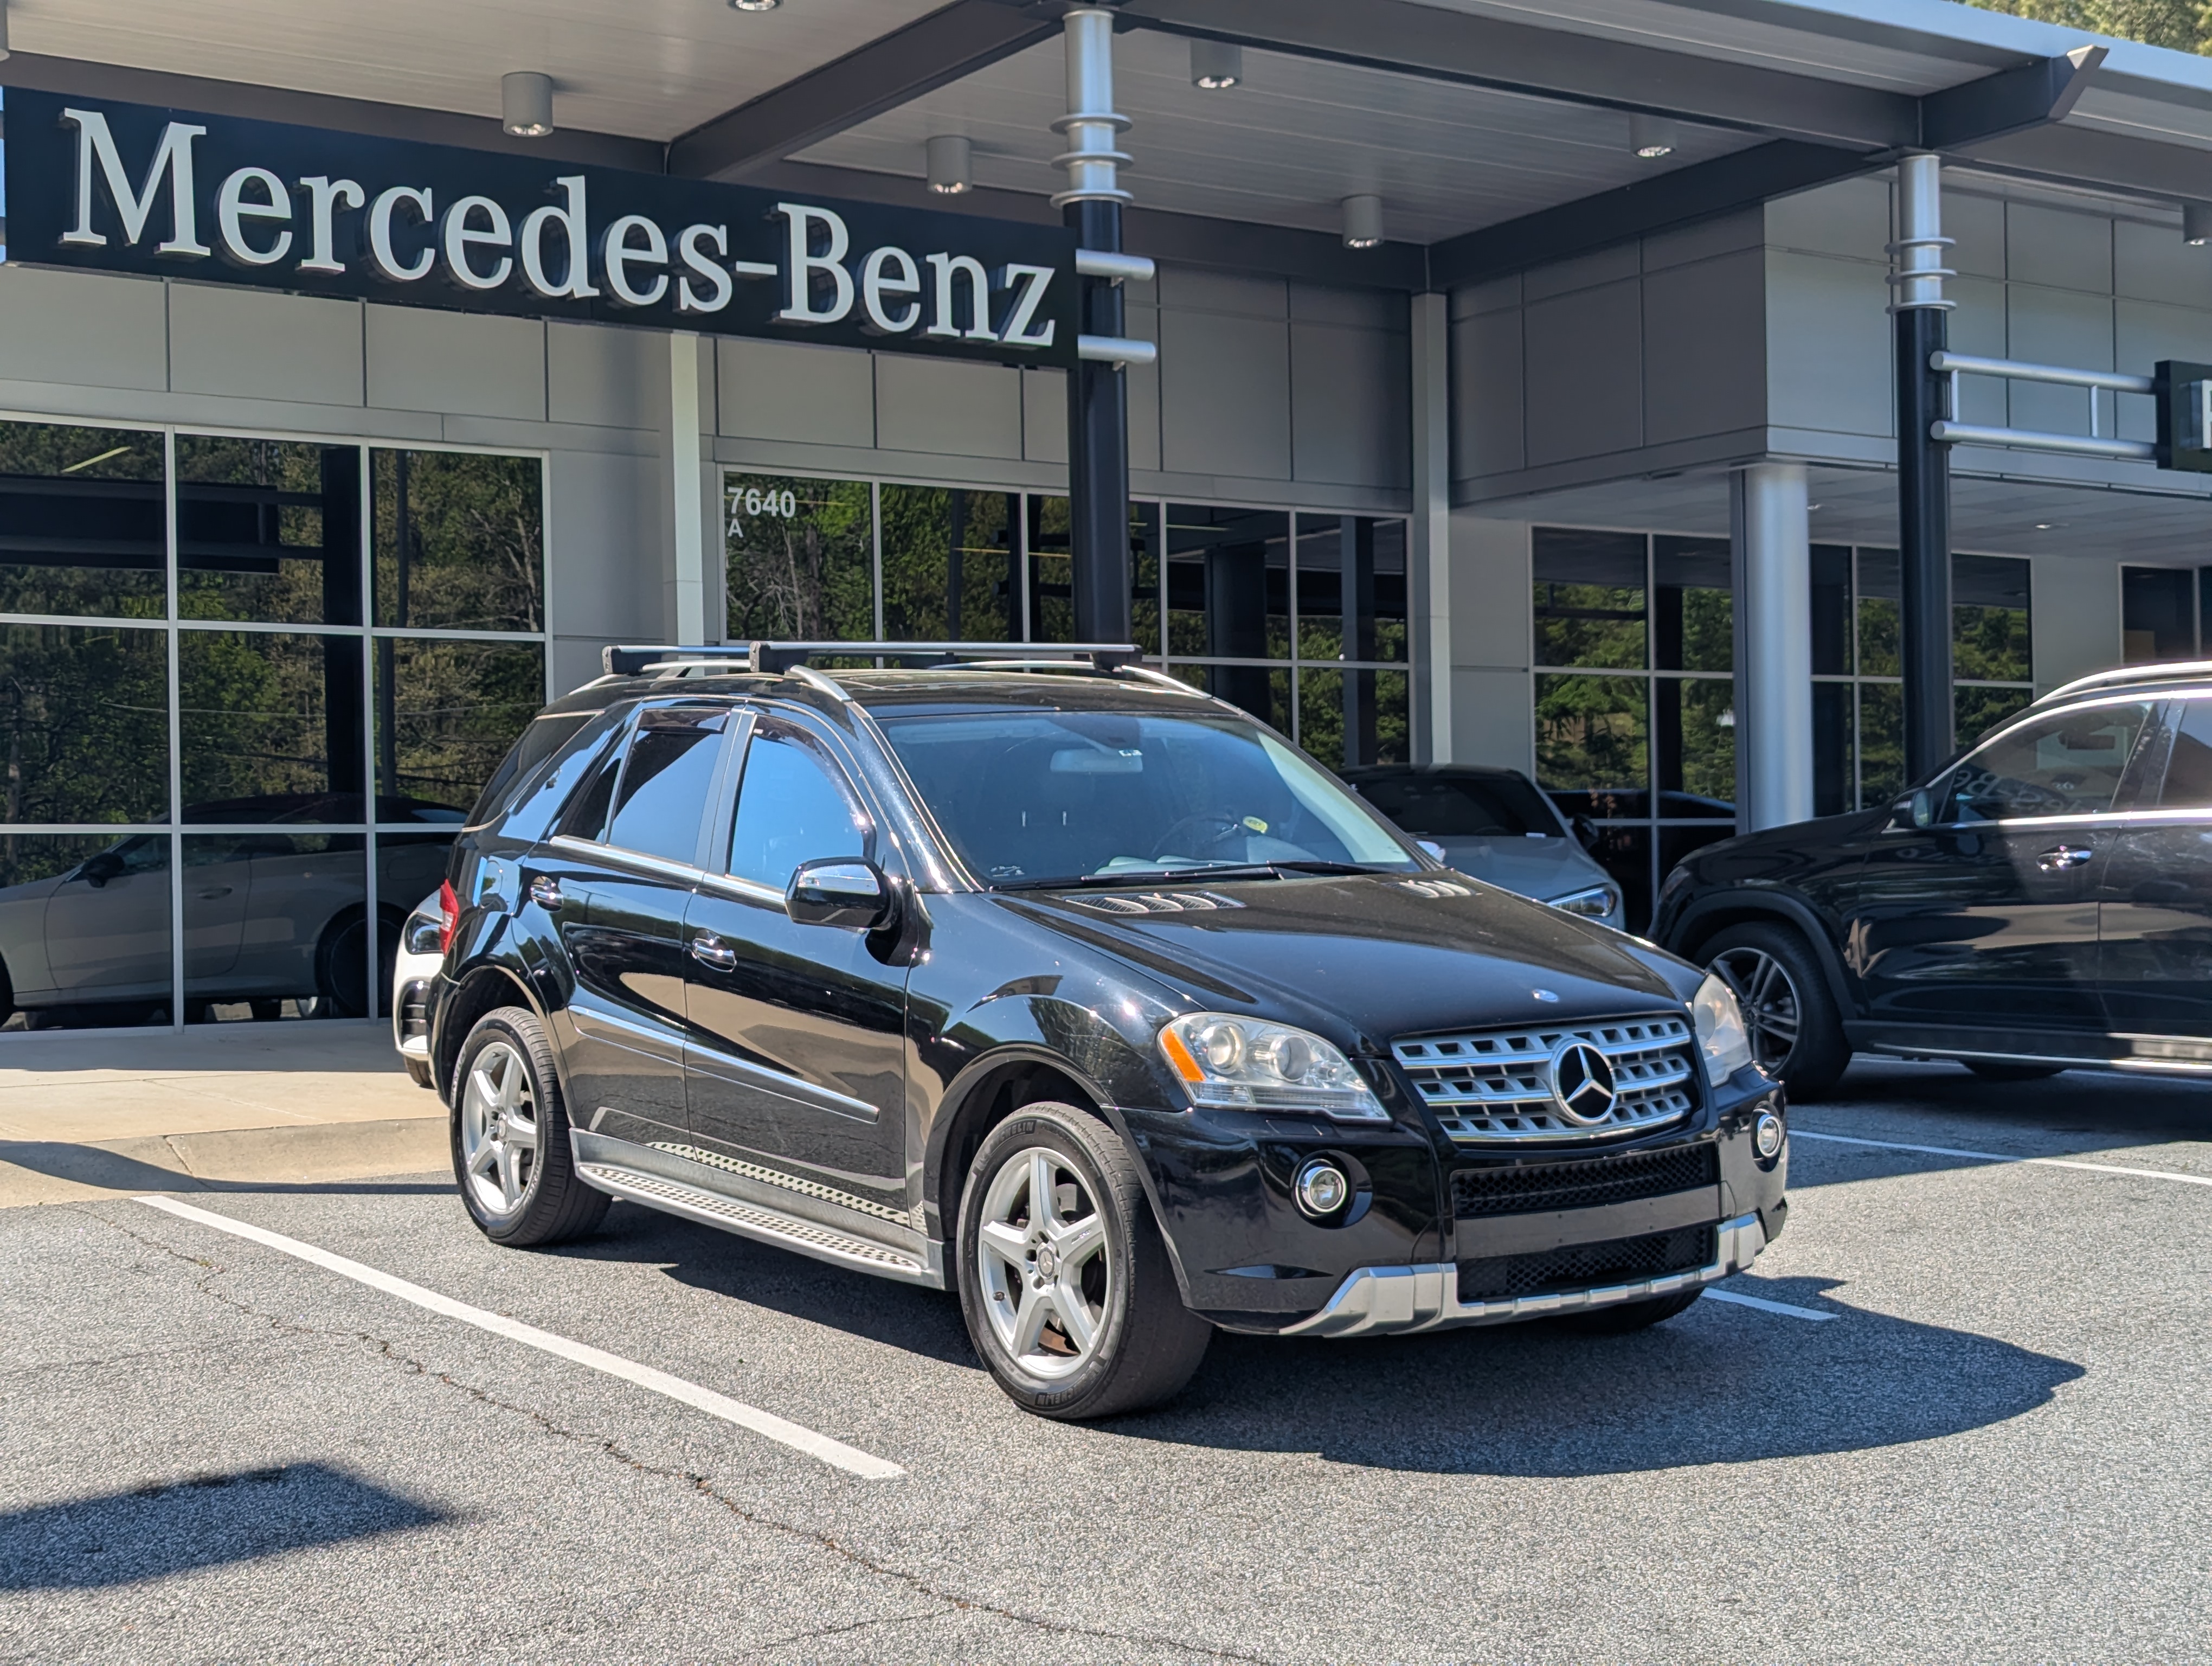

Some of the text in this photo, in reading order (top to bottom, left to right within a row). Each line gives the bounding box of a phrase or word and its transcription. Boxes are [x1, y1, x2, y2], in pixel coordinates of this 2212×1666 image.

[63, 107, 1056, 346] Mercedes-Benz
[728, 487, 795, 518] 7640
[728, 518, 743, 537] A
